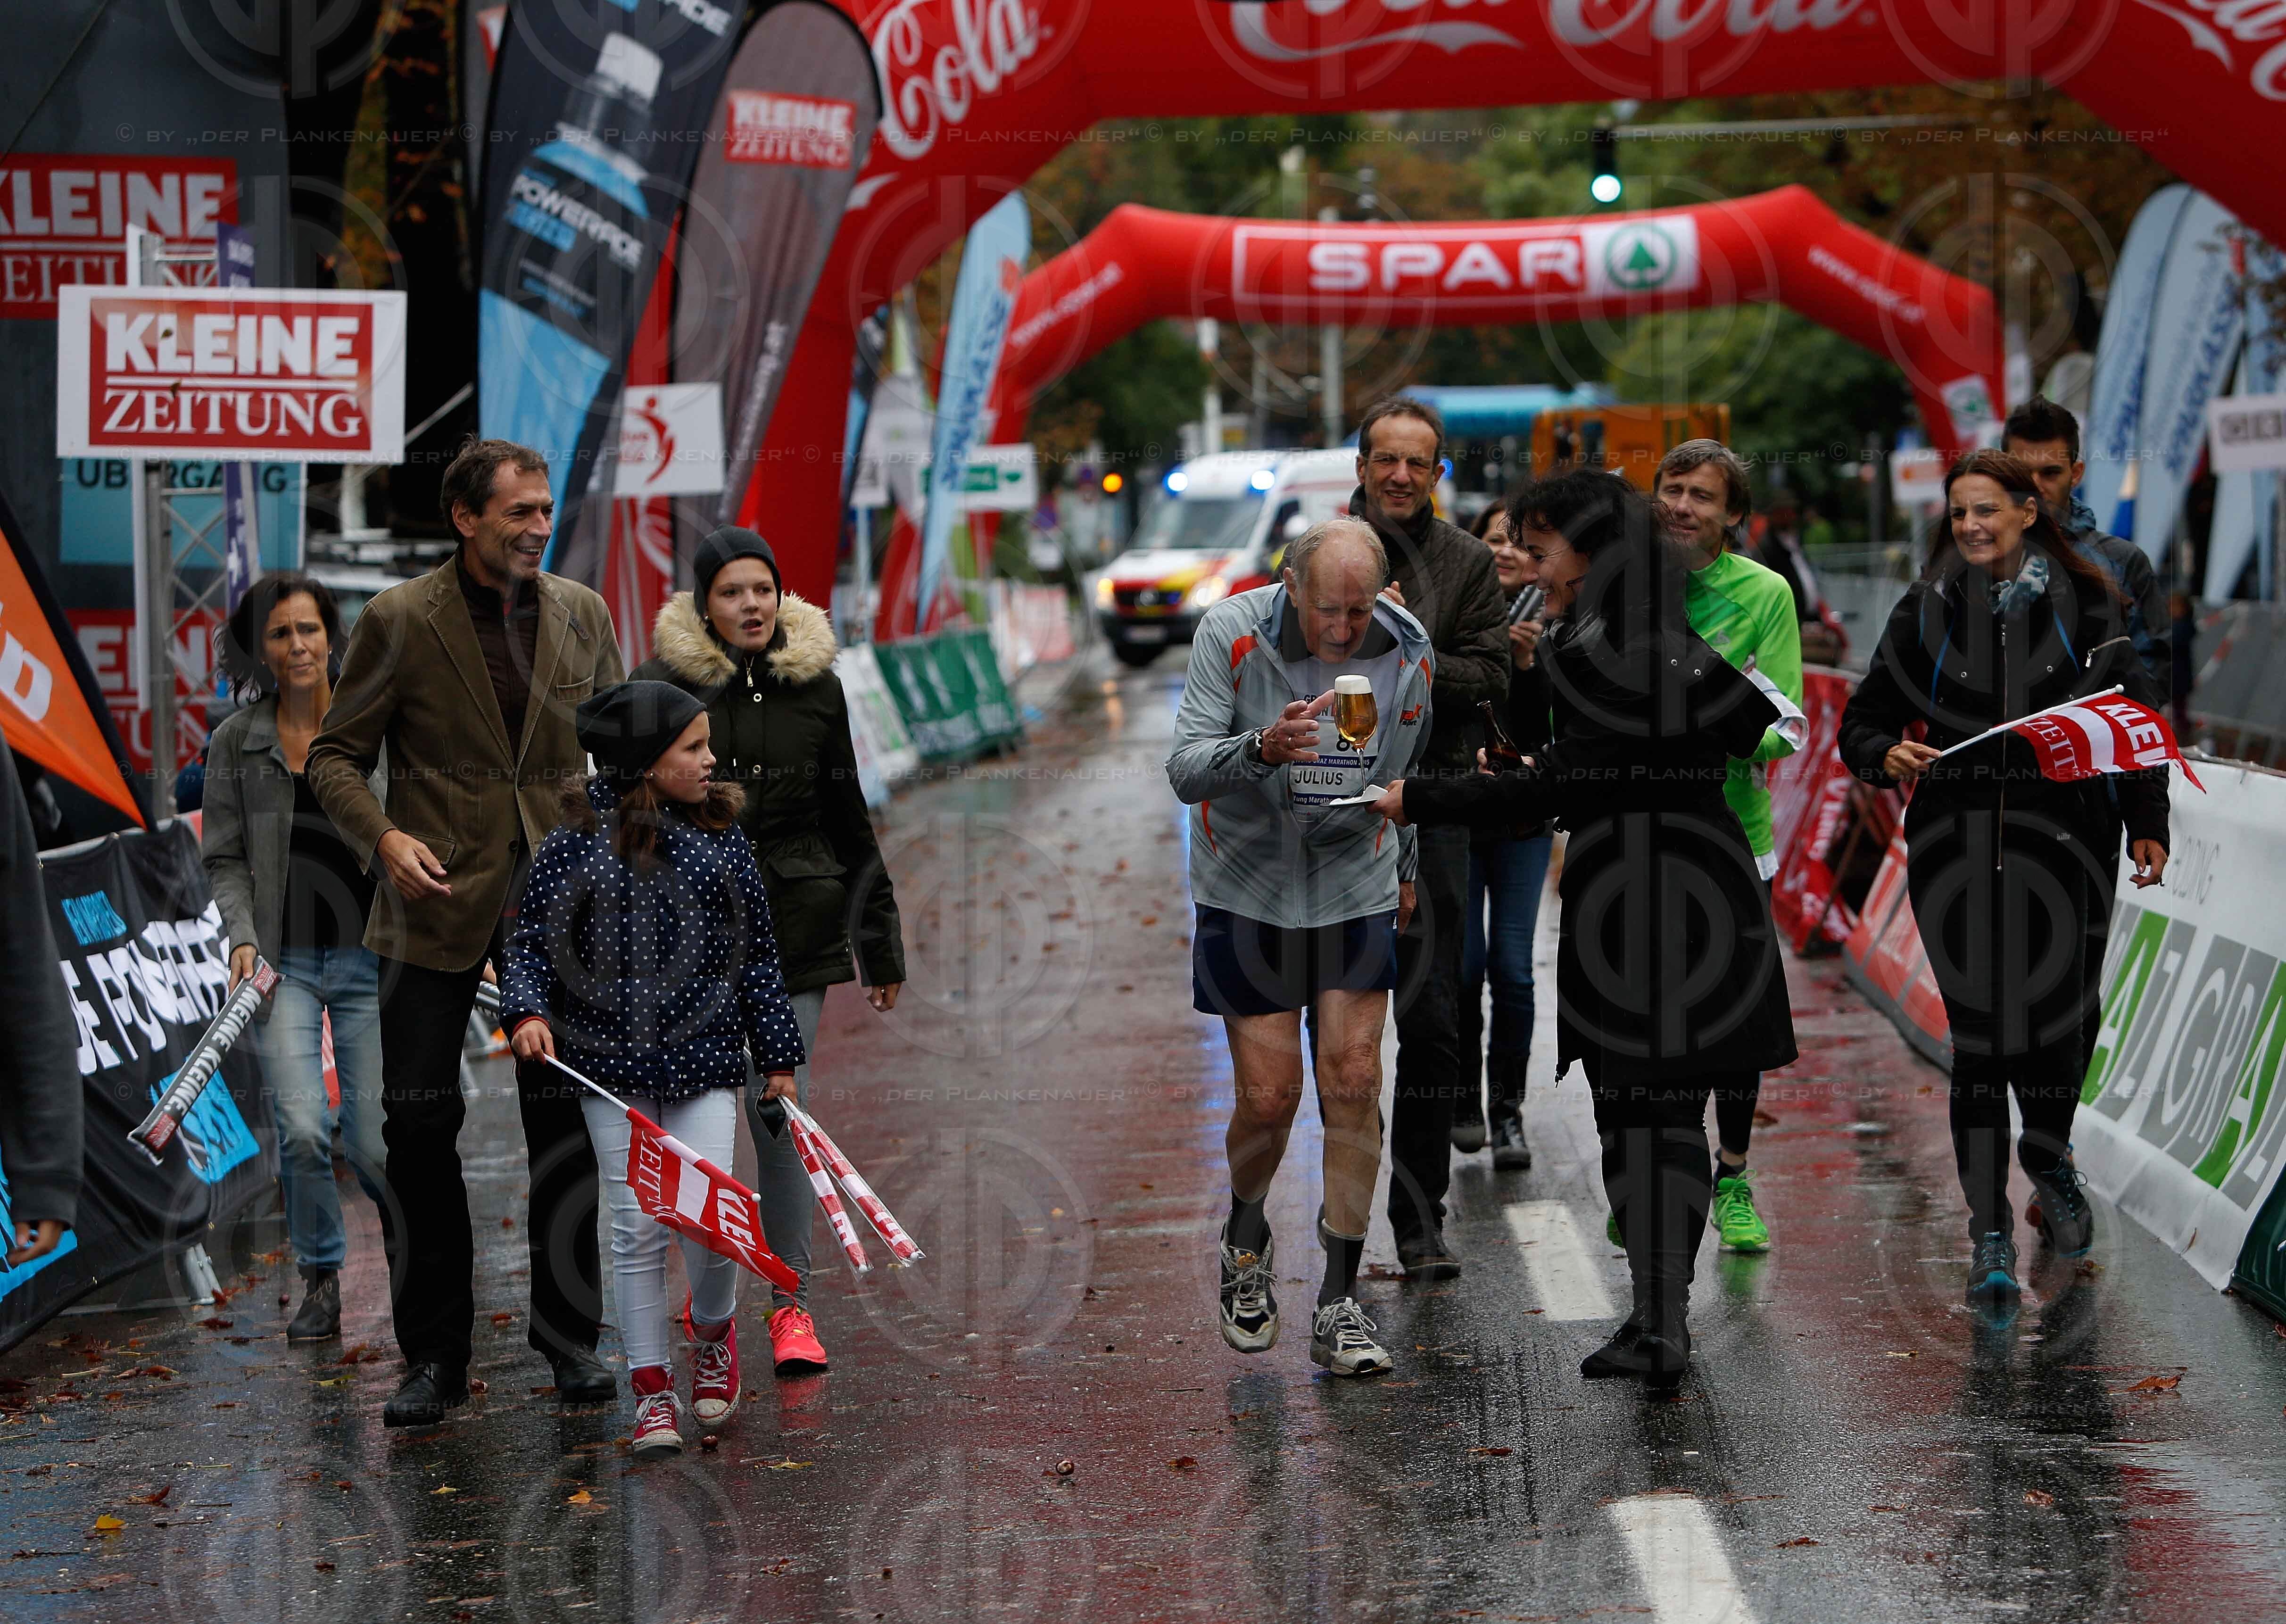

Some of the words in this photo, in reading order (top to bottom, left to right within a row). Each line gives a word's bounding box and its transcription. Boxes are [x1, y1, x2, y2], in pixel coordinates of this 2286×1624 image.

[734, 97, 852, 134] KLEINE
[0, 169, 225, 238] LEINE
[1308, 239, 1583, 291] SPAR
[105, 312, 360, 377] KLEINE
[102, 388, 362, 438] ZEITUNG
[1294, 771, 1343, 786] JULIUS
[211, 985, 262, 1053] MEINE
[163, 1044, 222, 1117] KLEINE.
